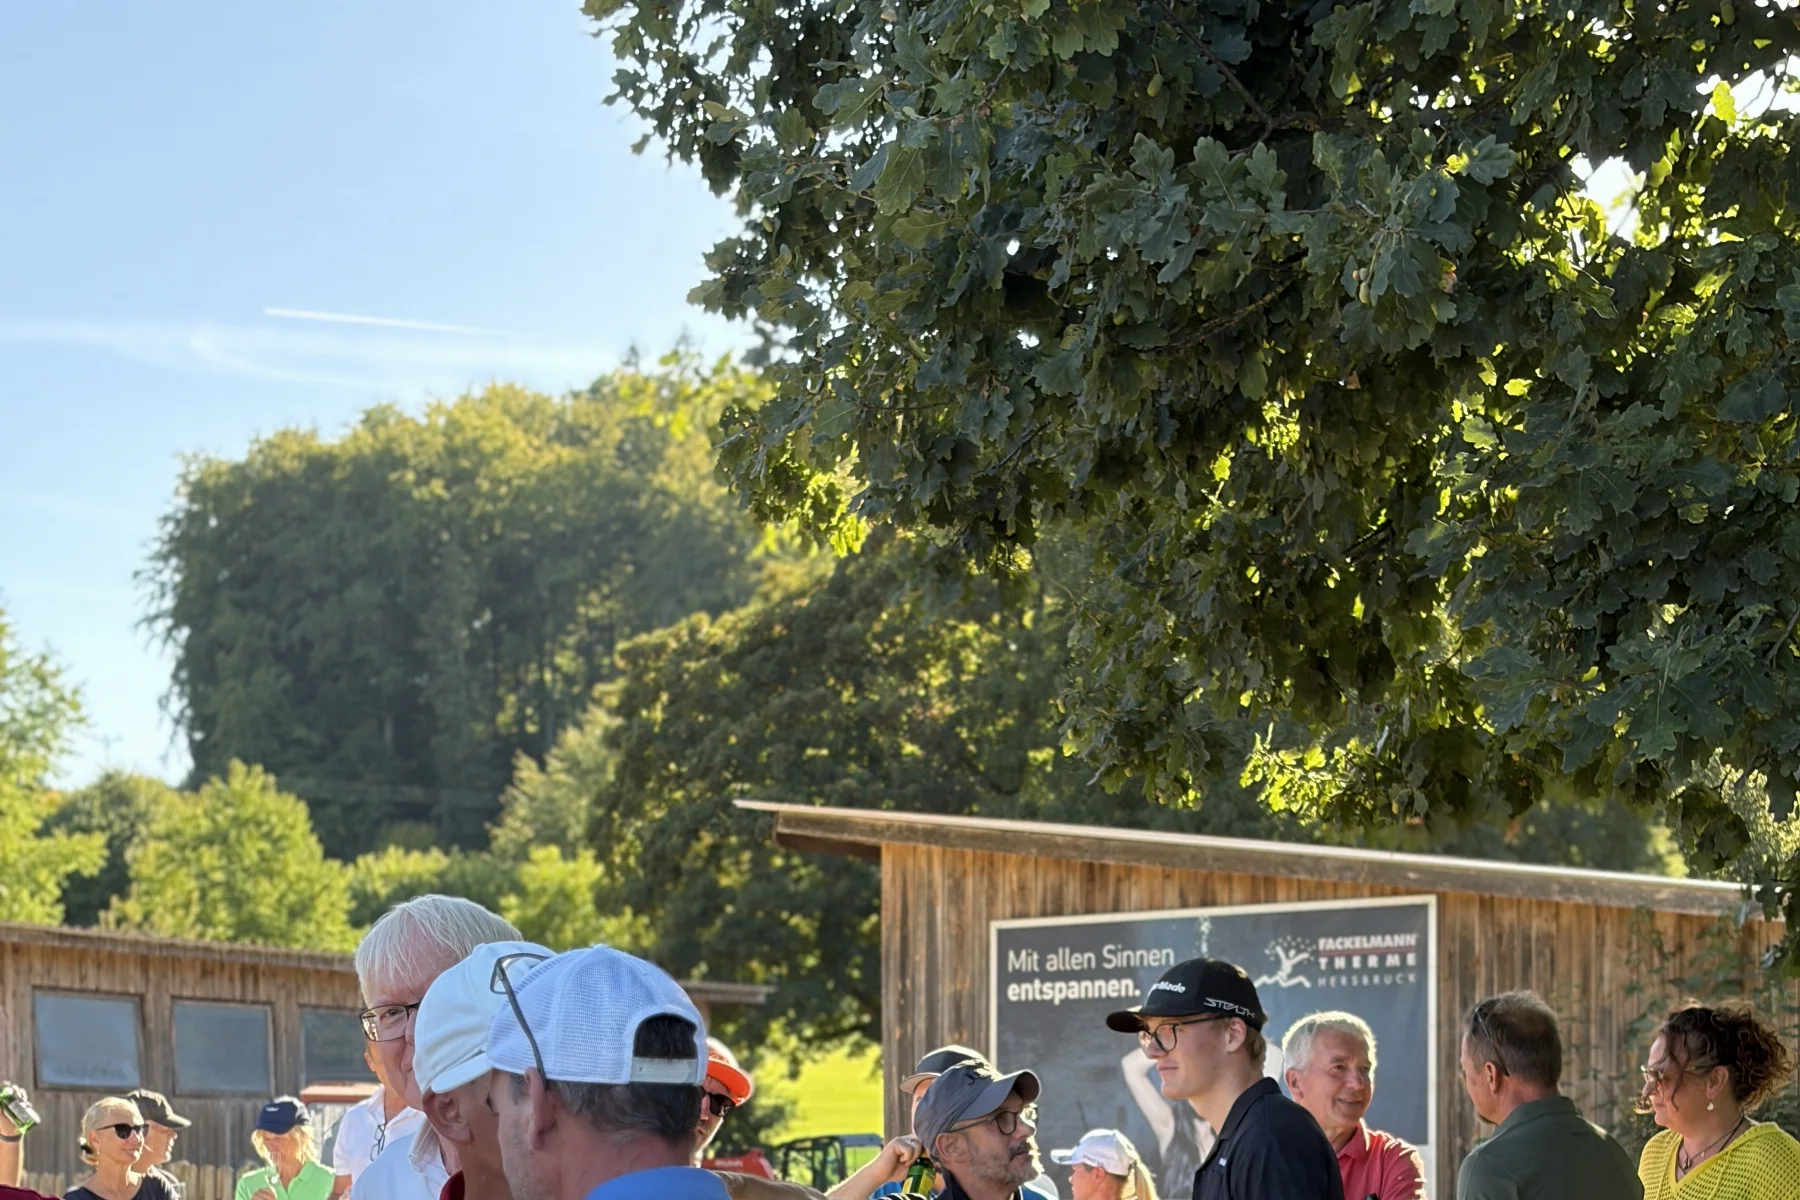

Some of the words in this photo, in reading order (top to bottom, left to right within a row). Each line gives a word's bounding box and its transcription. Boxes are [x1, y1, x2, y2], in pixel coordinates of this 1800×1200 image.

[1319, 933, 1416, 951] FACKELMANN
[1007, 948, 1039, 973] Mit
[1045, 946, 1096, 972] allen
[1103, 944, 1175, 969] Sinnen
[1318, 953, 1416, 970] THERME
[1318, 973, 1416, 987] HERSBRUCK
[1007, 978, 1141, 1005] entspannen.
